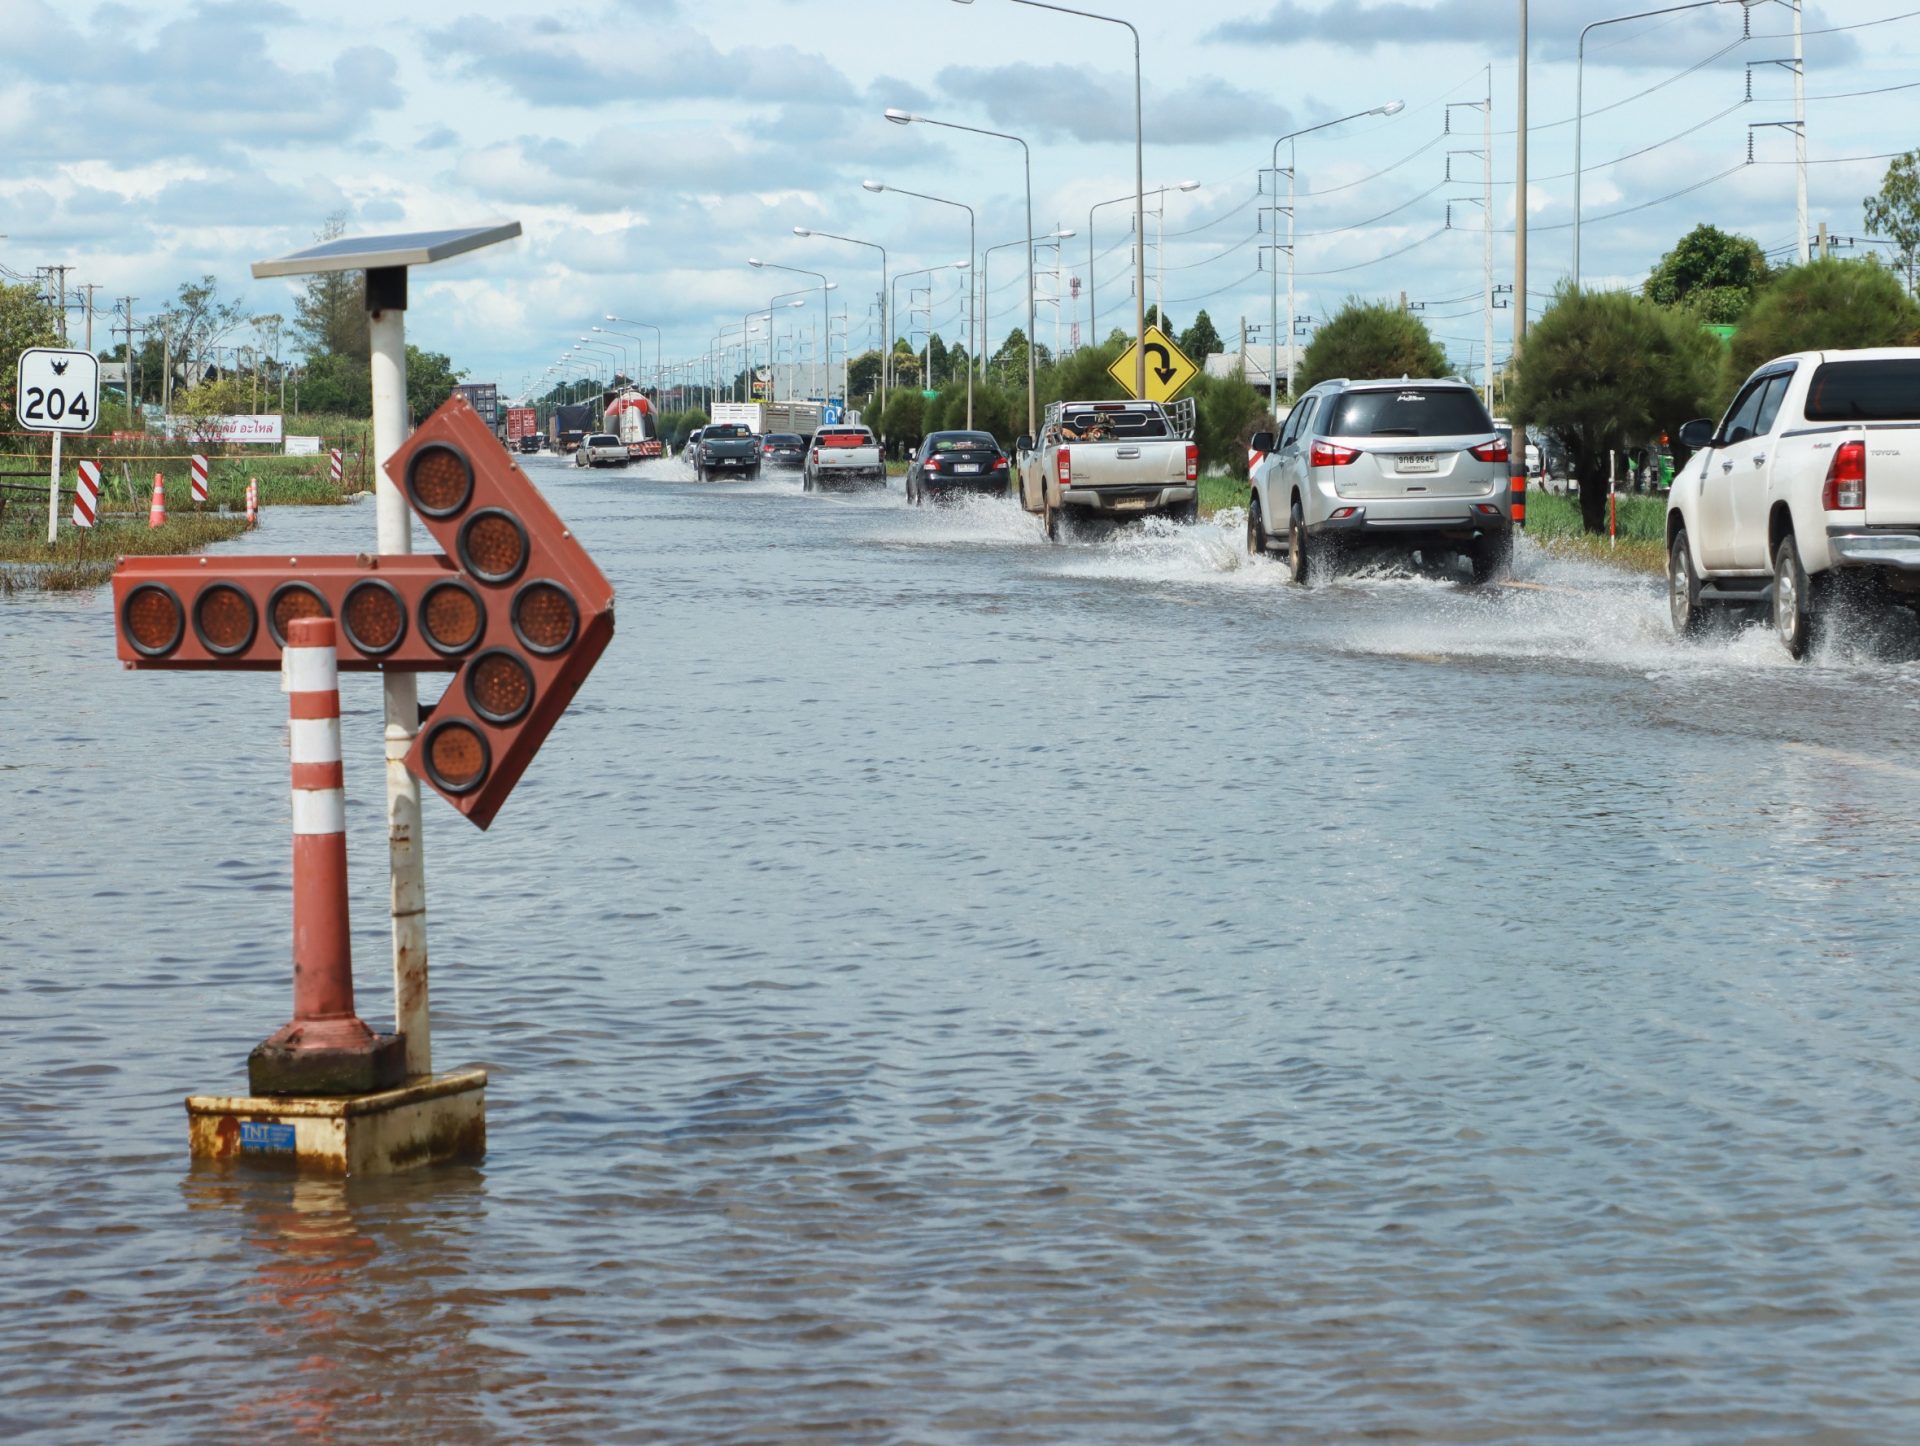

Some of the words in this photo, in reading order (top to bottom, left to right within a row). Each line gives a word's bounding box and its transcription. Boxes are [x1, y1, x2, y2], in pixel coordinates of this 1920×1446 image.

[25, 386, 89, 422] 204
[1416, 455, 1434, 464] 2545
[241, 1124, 270, 1140] TNT
